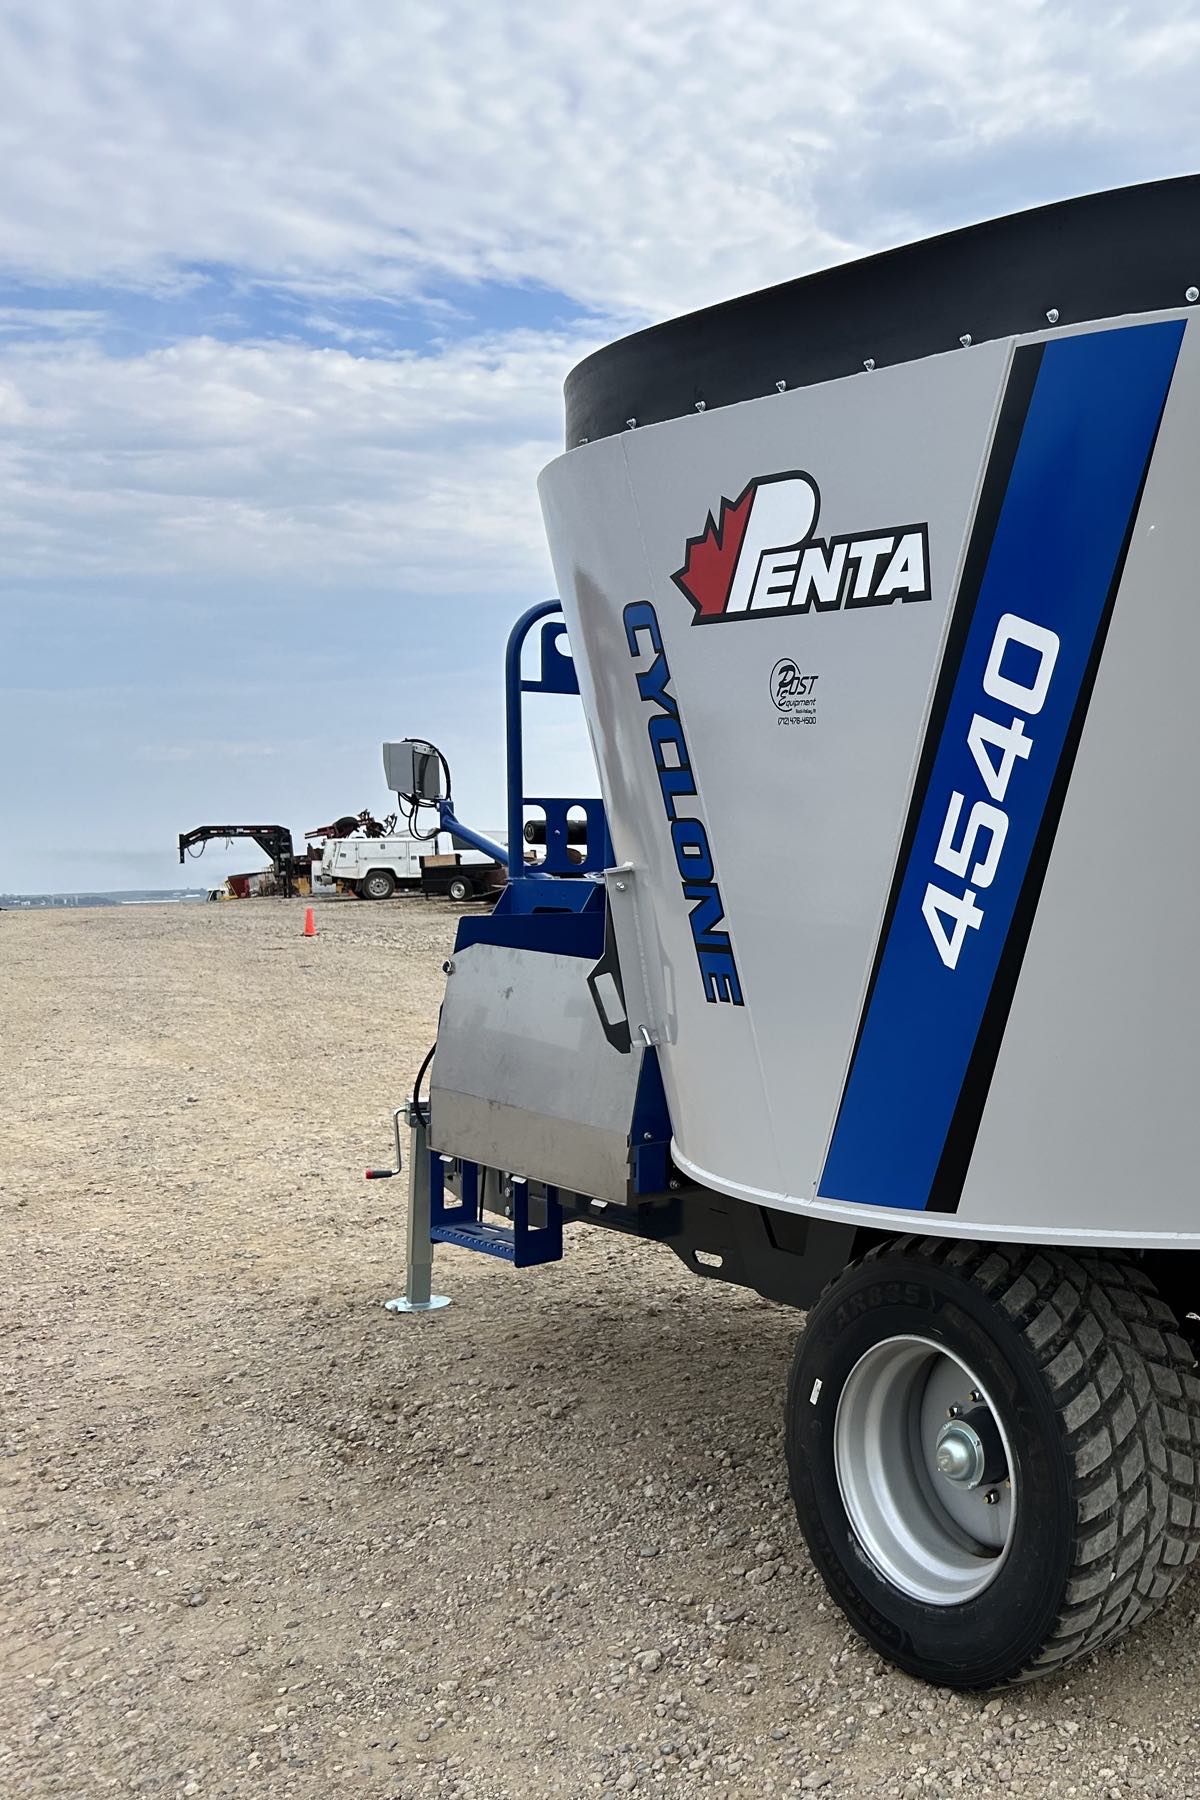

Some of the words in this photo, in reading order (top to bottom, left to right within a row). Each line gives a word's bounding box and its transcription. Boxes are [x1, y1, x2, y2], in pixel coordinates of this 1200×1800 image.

[724, 474, 929, 613] PENTA
[622, 600, 745, 1007] CYCLONE
[921, 612, 1061, 971] 4540
